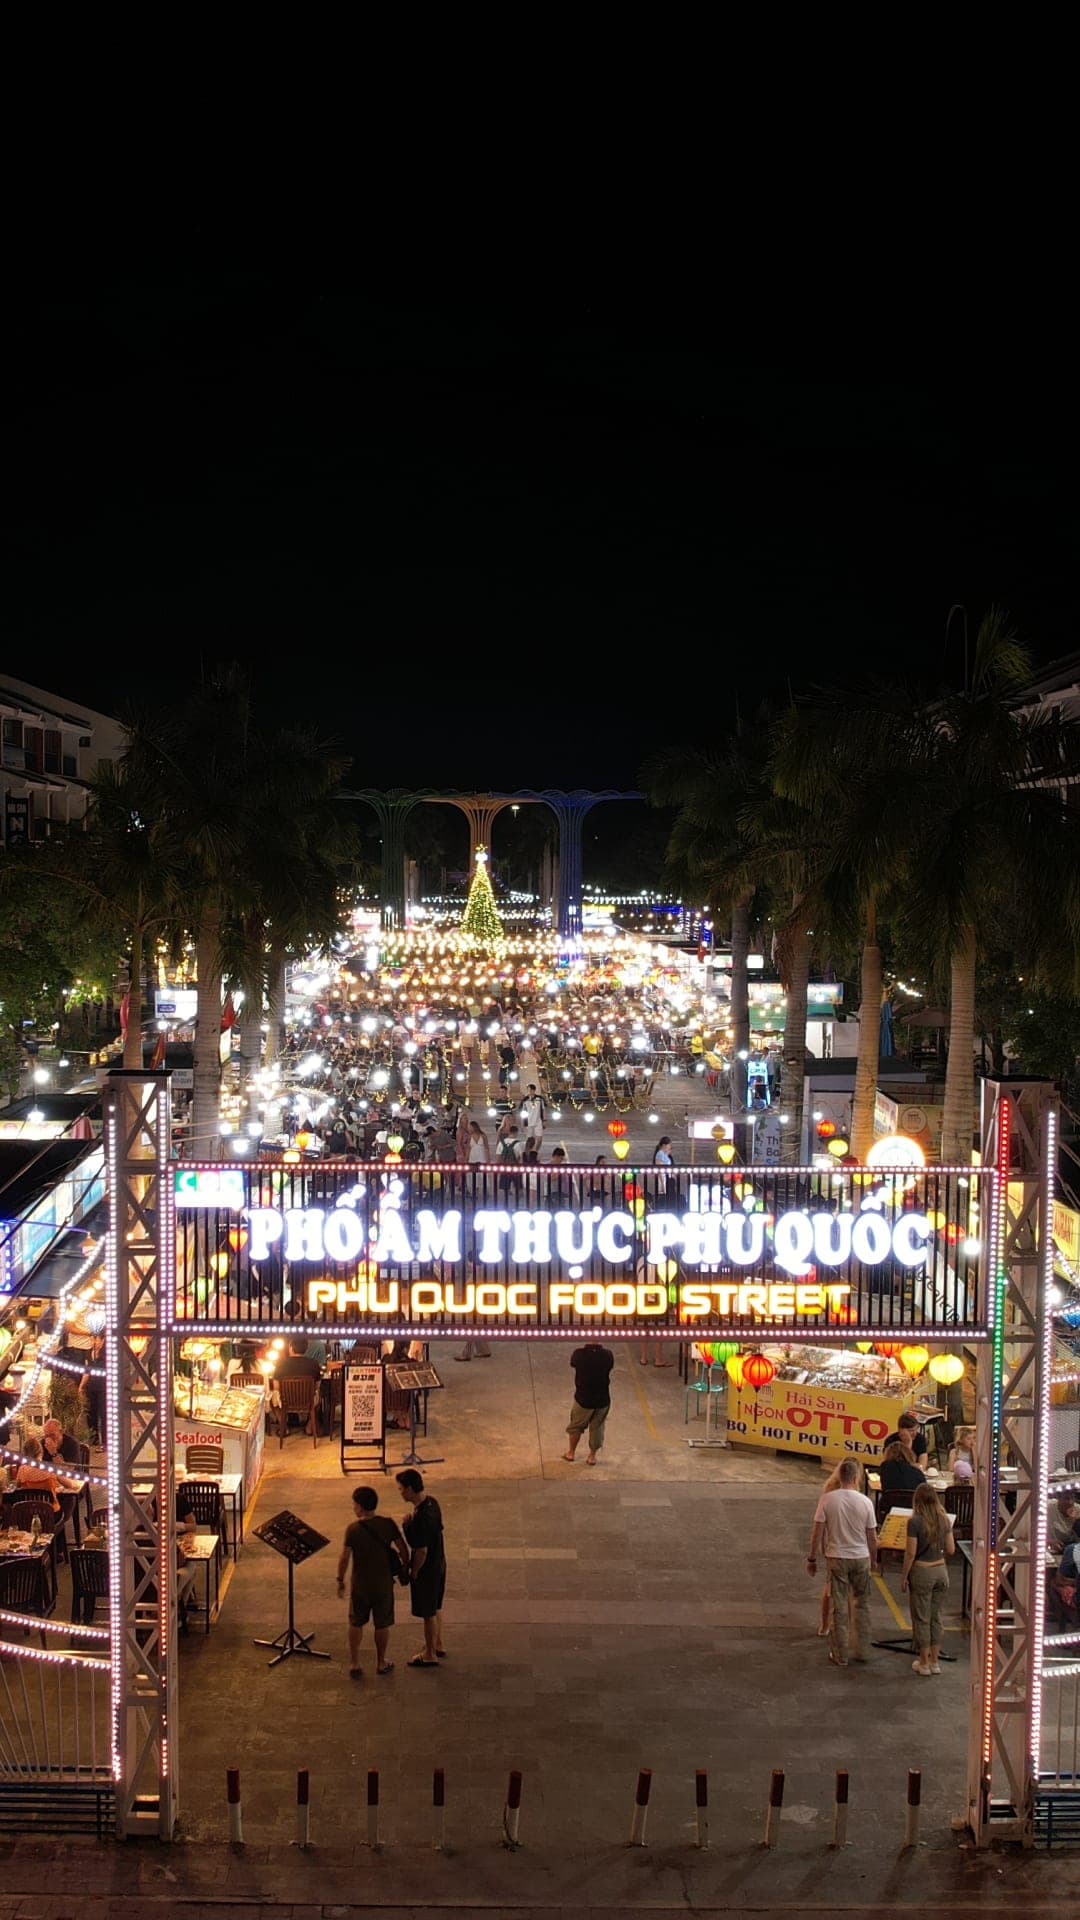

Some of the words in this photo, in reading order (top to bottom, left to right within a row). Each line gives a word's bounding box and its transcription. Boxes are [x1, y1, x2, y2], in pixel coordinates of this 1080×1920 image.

[249, 1184, 366, 1262] PHỐ
[371, 1179, 462, 1263] ẨM
[473, 1206, 635, 1279] THỰC
[646, 1195, 769, 1265] PHÚ
[774, 1187, 930, 1276] QUỐC
[308, 1281, 398, 1312] PHU
[411, 1282, 537, 1314] QUOC
[549, 1284, 667, 1315] FOOD
[680, 1284, 851, 1316] STREET
[786, 1391, 812, 1406] Hải
[815, 1395, 846, 1412] Sản
[744, 1403, 784, 1421] NGON
[786, 1407, 889, 1440] OTTO
[175, 1432, 222, 1444] Seafood
[762, 1426, 793, 1441] HOT
[798, 1432, 829, 1447] POT
